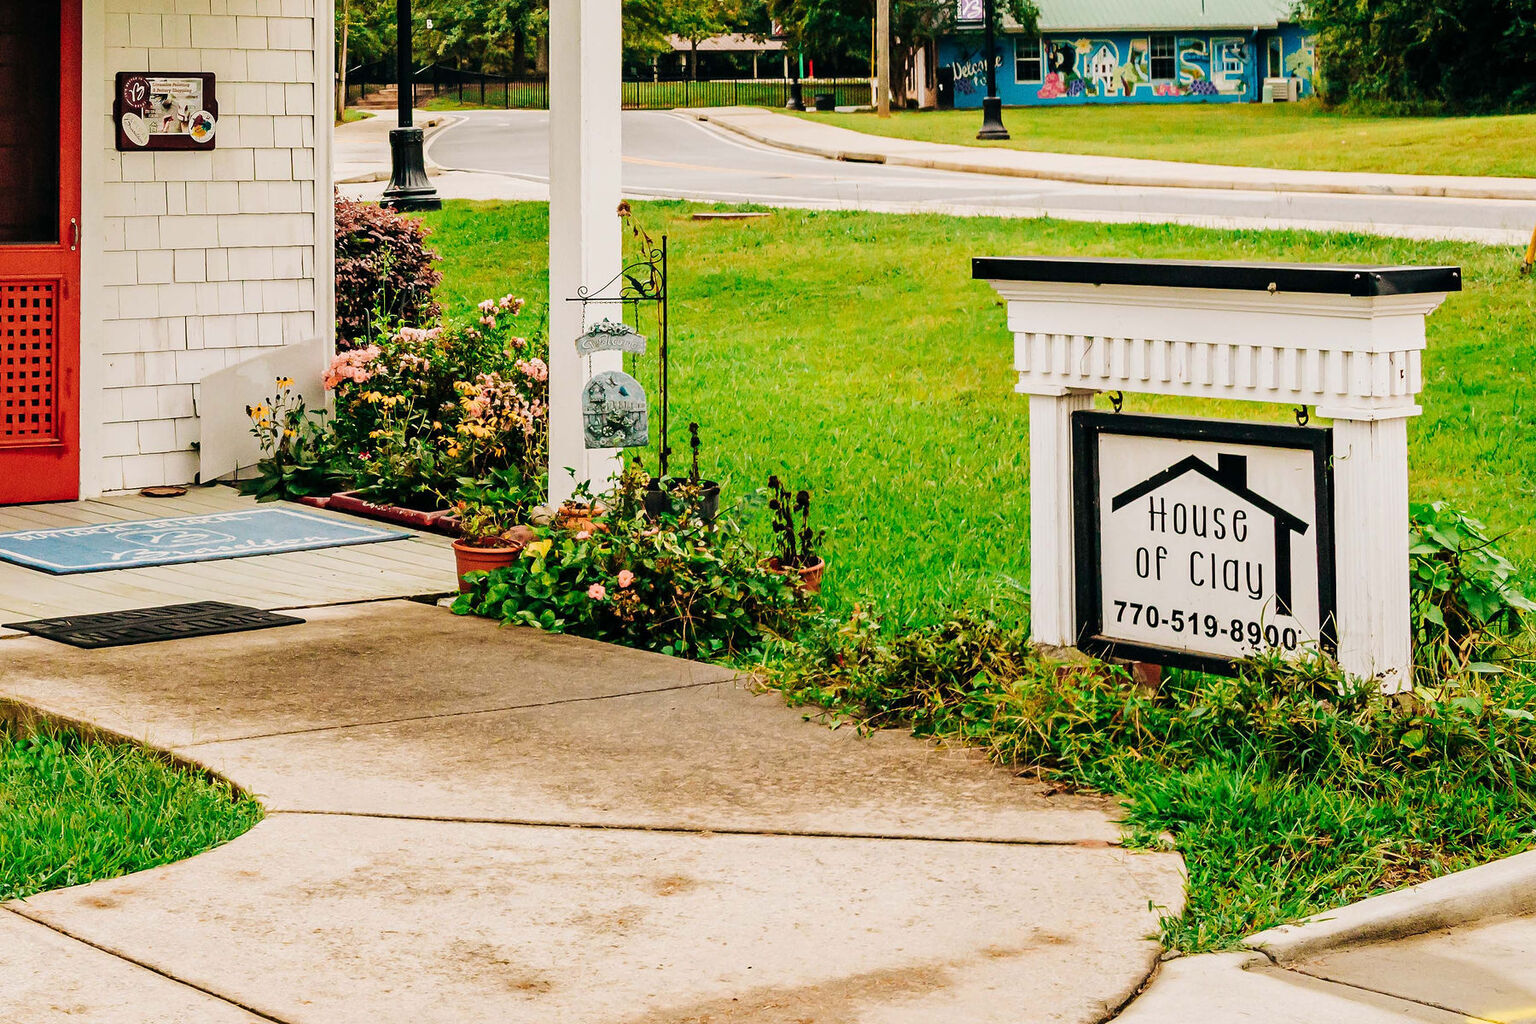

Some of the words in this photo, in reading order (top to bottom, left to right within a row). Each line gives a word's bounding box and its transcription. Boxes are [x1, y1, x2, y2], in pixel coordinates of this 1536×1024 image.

[1148, 496, 1248, 543] House
[1136, 546, 1168, 580] of
[1190, 550, 1264, 600] Clay
[1114, 601, 1297, 651] 770-519-8900
